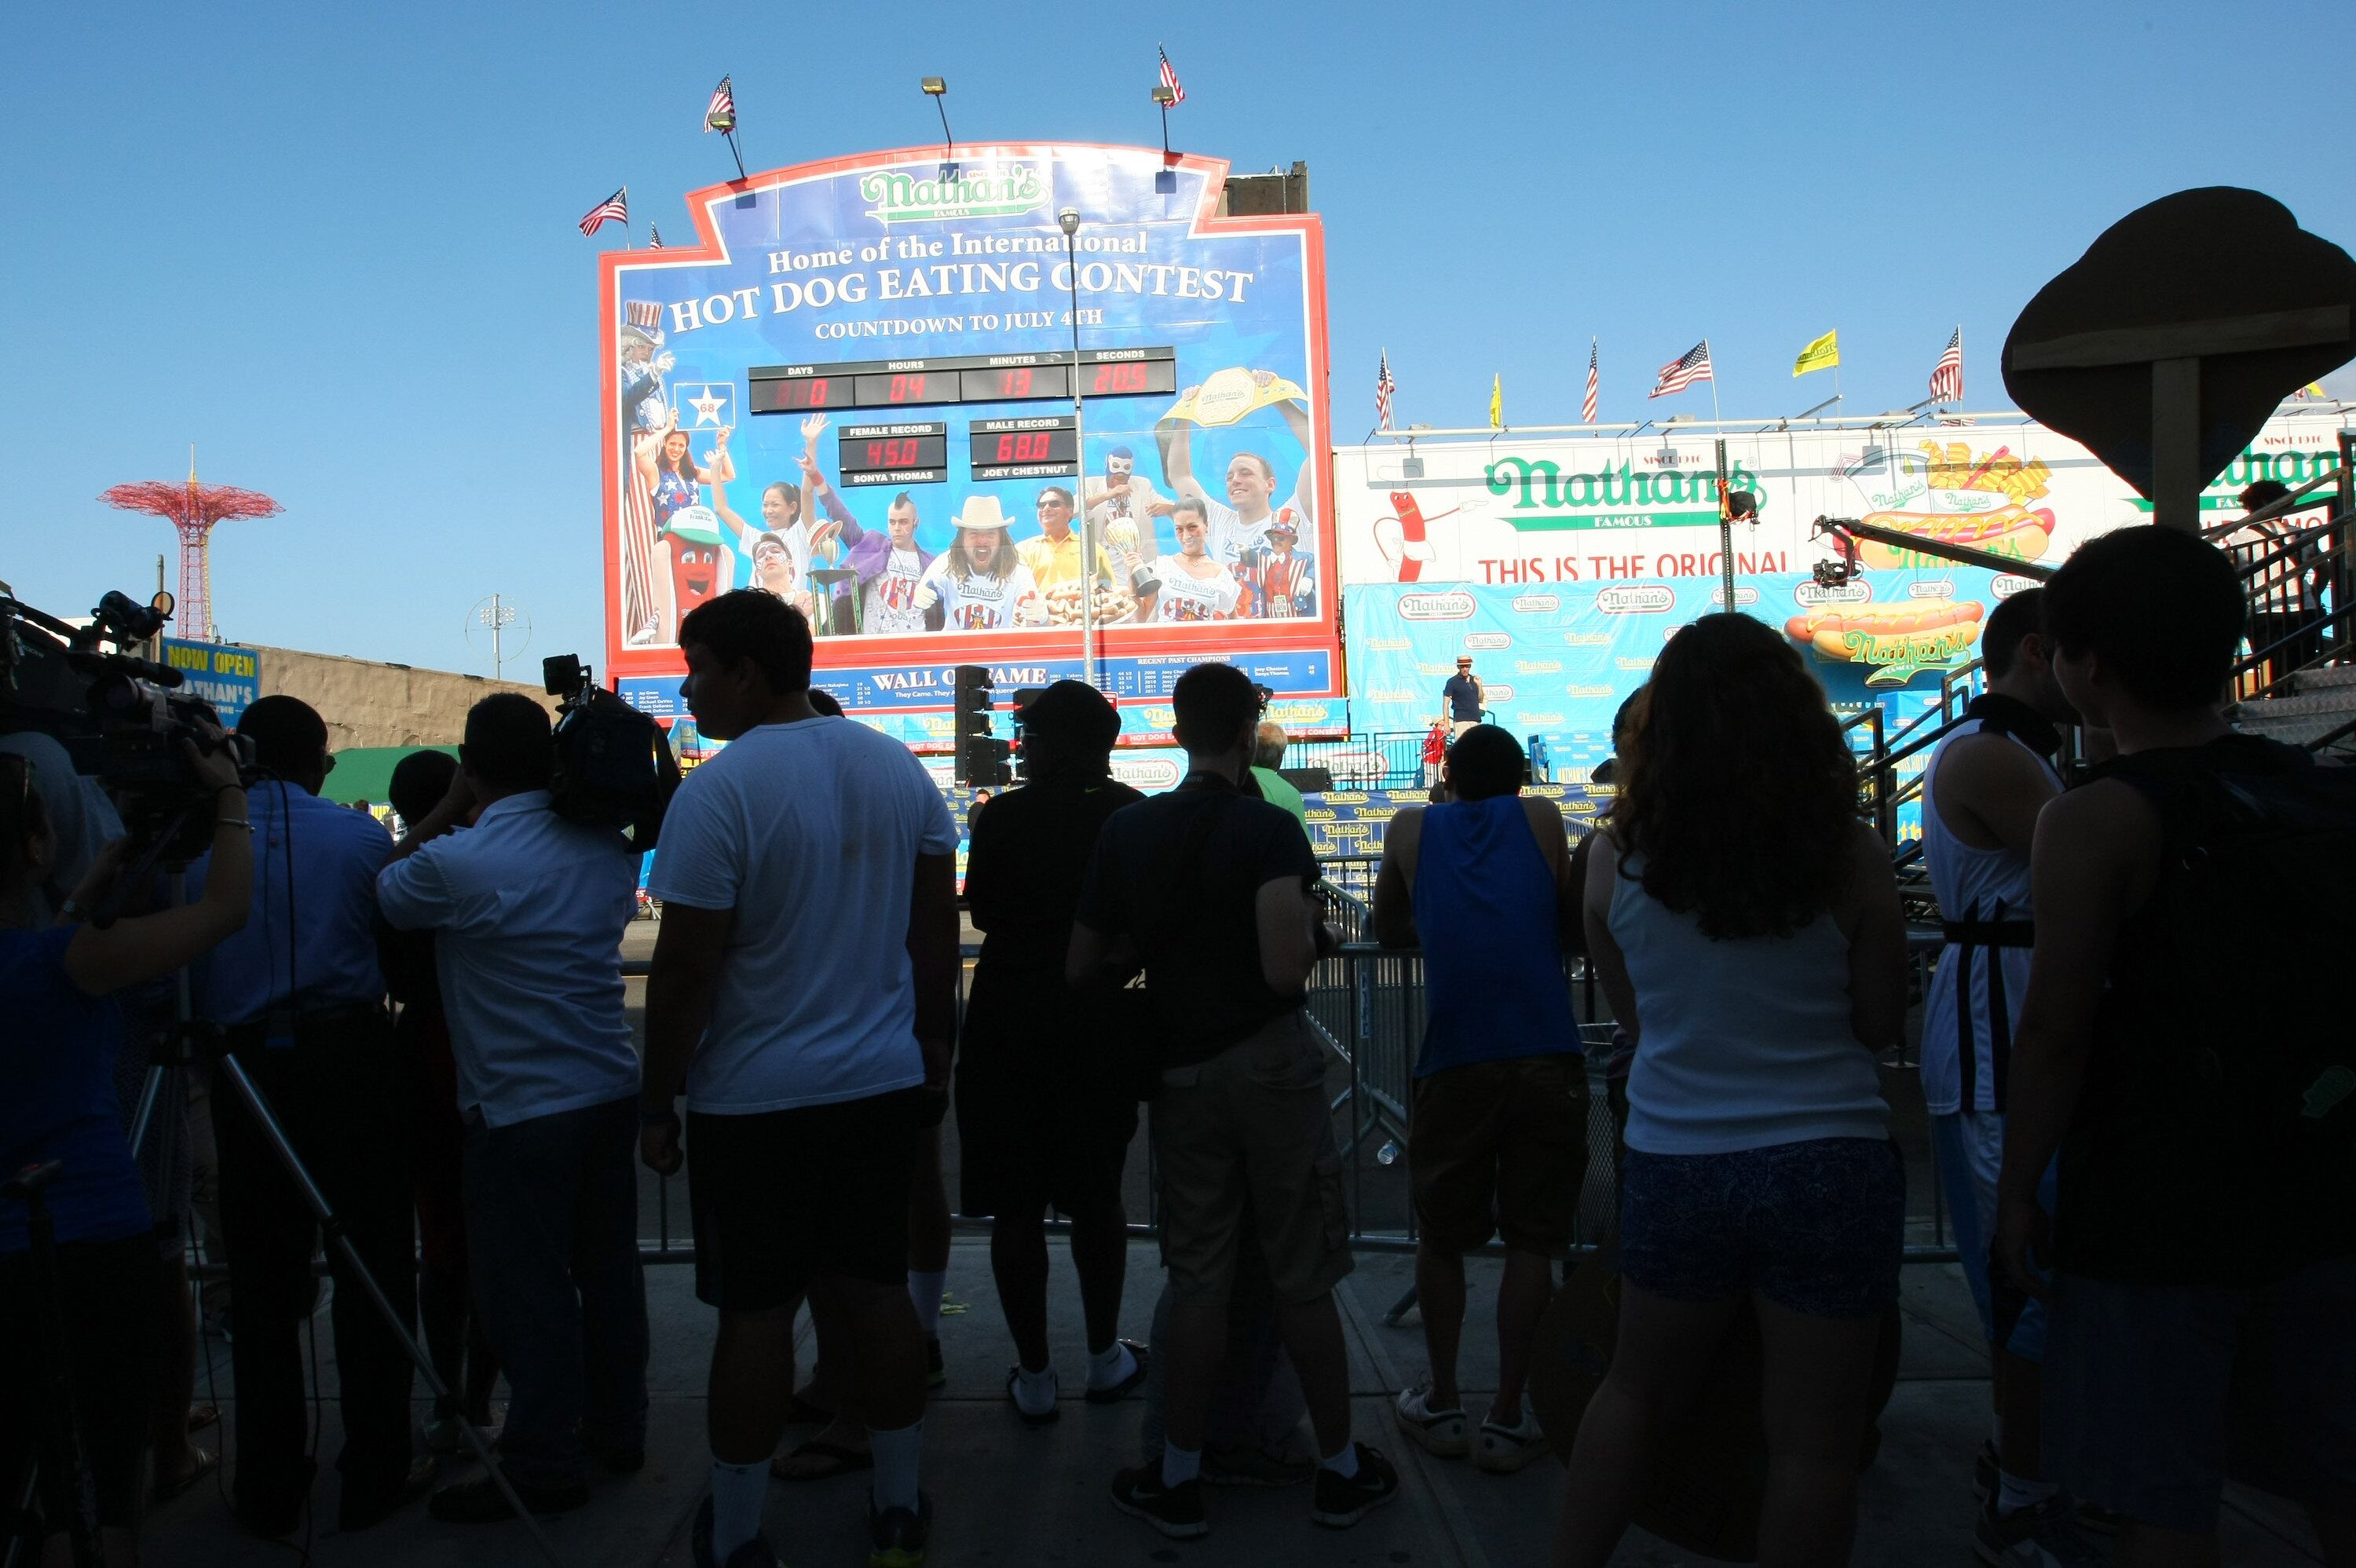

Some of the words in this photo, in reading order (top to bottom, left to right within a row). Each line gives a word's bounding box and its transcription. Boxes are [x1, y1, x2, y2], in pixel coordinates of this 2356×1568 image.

[862, 165, 1046, 208] Nathan's
[767, 248, 854, 274] Home
[861, 236, 891, 262] of
[892, 233, 942, 258] the
[951, 231, 1147, 256] International
[668, 285, 761, 334] HOT
[770, 271, 869, 314] DOG
[877, 261, 1042, 301] EATING
[1050, 261, 1254, 305] CONTEST
[814, 316, 964, 340] COUNTDOWN
[968, 314, 1000, 332] TO
[1004, 311, 1056, 332] JULY
[1060, 309, 1103, 327] 4TH
[788, 367, 814, 375] DAYS
[888, 361, 924, 371] HOURS
[990, 356, 1036, 366] MINUTES
[1096, 350, 1145, 360] SECONDS
[890, 375, 926, 402] 04
[700, 403, 715, 413] 68
[850, 426, 888, 436] FEMALE
[891, 425, 932, 434] RECORD
[986, 421, 1016, 430] MALE
[1017, 419, 1059, 428] RECORD
[2264, 436, 2294, 445] SINCE
[2299, 435, 2324, 444] 1916
[1643, 455, 1675, 464] SINCE
[1677, 455, 1703, 463] 1916
[854, 473, 887, 483] SONYA
[890, 471, 933, 481] THOMAS
[982, 468, 1011, 477] JOEY
[1012, 466, 1068, 476] CHESTNUT
[1871, 480, 1927, 507] Nathan's
[1945, 492, 1992, 506] Nathan's
[1594, 514, 1652, 528] FAMOUS
[1478, 556, 1545, 585] THIS
[1556, 556, 1579, 583] IS
[1403, 596, 1470, 613] Nathan's
[1516, 597, 1557, 609] Nathan's
[1602, 590, 1671, 606] Nathan's
[1467, 634, 1509, 645] Nathan's
[1842, 629, 1972, 665] Nathan's
[167, 645, 209, 671] NOW
[214, 652, 254, 678] OPEN
[1187, 655, 1231, 663] CHAMPIONS
[1516, 660, 1563, 672] Nathan's
[1886, 664, 1915, 674] FAMOUS
[871, 670, 937, 690] WALL
[942, 670, 955, 685] O
[1567, 685, 1614, 696] Nathan's
[1321, 791, 1370, 802] Nathan's
